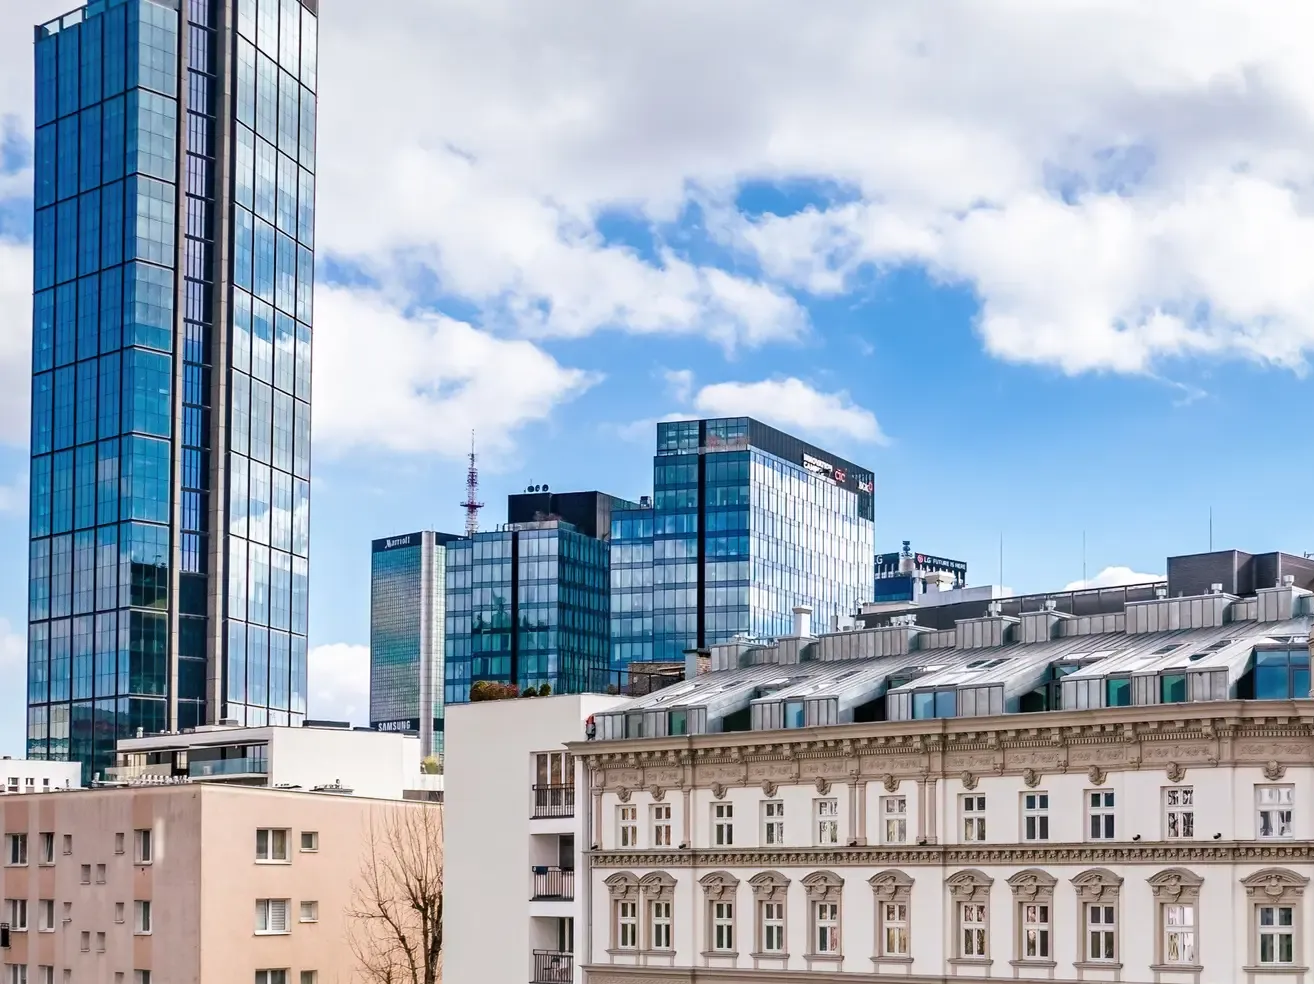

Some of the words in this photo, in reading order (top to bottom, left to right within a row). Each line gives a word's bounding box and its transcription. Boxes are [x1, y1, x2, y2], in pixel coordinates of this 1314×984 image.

[384, 536, 410, 549] Marriott
[923, 556, 932, 564] LG
[378, 720, 411, 732] SAMSUNG
